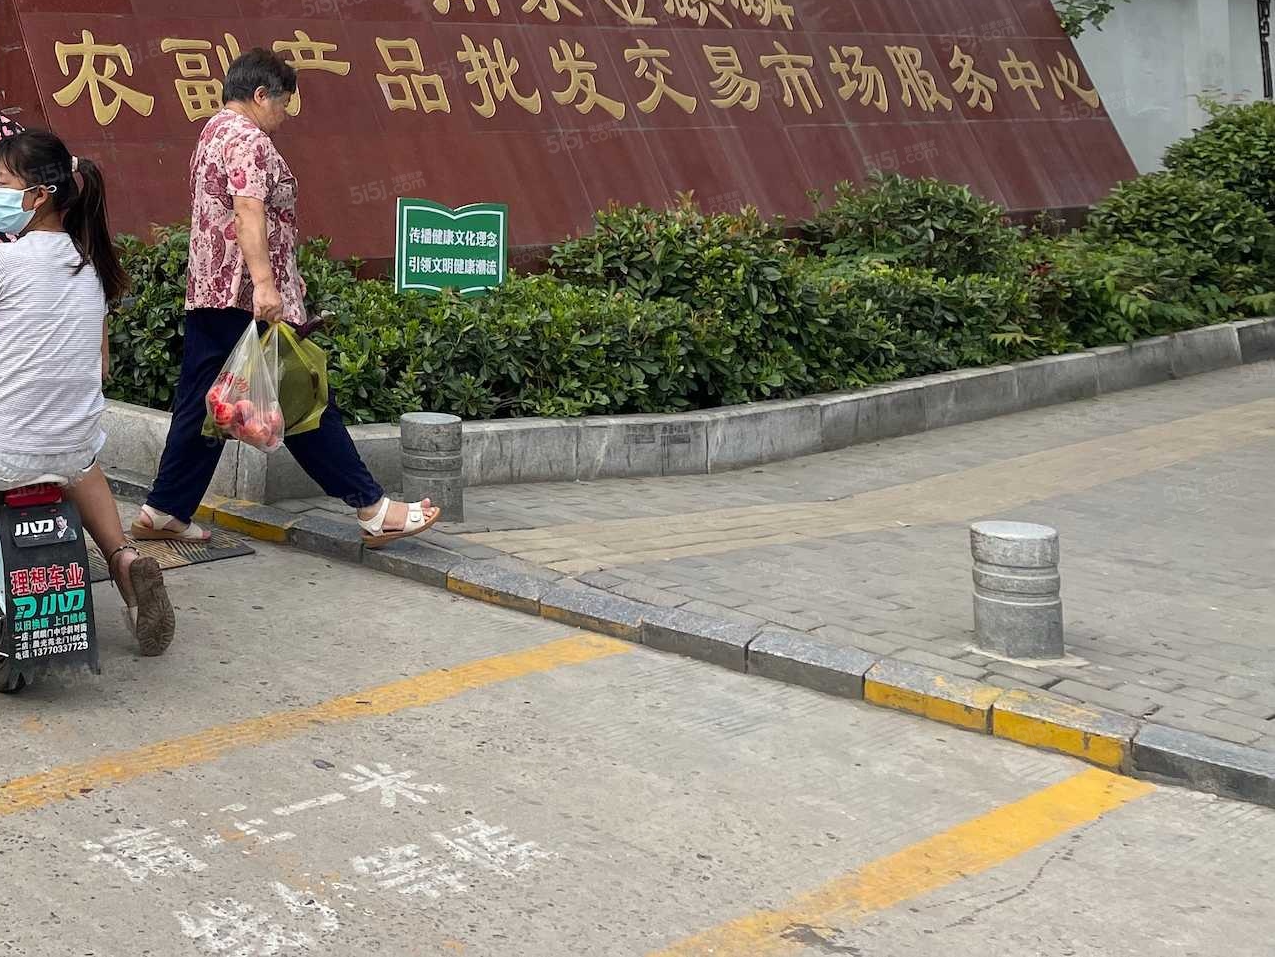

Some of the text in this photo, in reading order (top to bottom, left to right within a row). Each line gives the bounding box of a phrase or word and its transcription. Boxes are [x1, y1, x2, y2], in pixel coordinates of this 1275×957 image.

[52, 29, 1102, 127] 农副产品批发交易市场服务中心
[409, 227, 498, 248] 传播健康文化理念
[409, 256, 497, 276] 引领文明健康潮流
[10, 563, 85, 595] 理想车业
